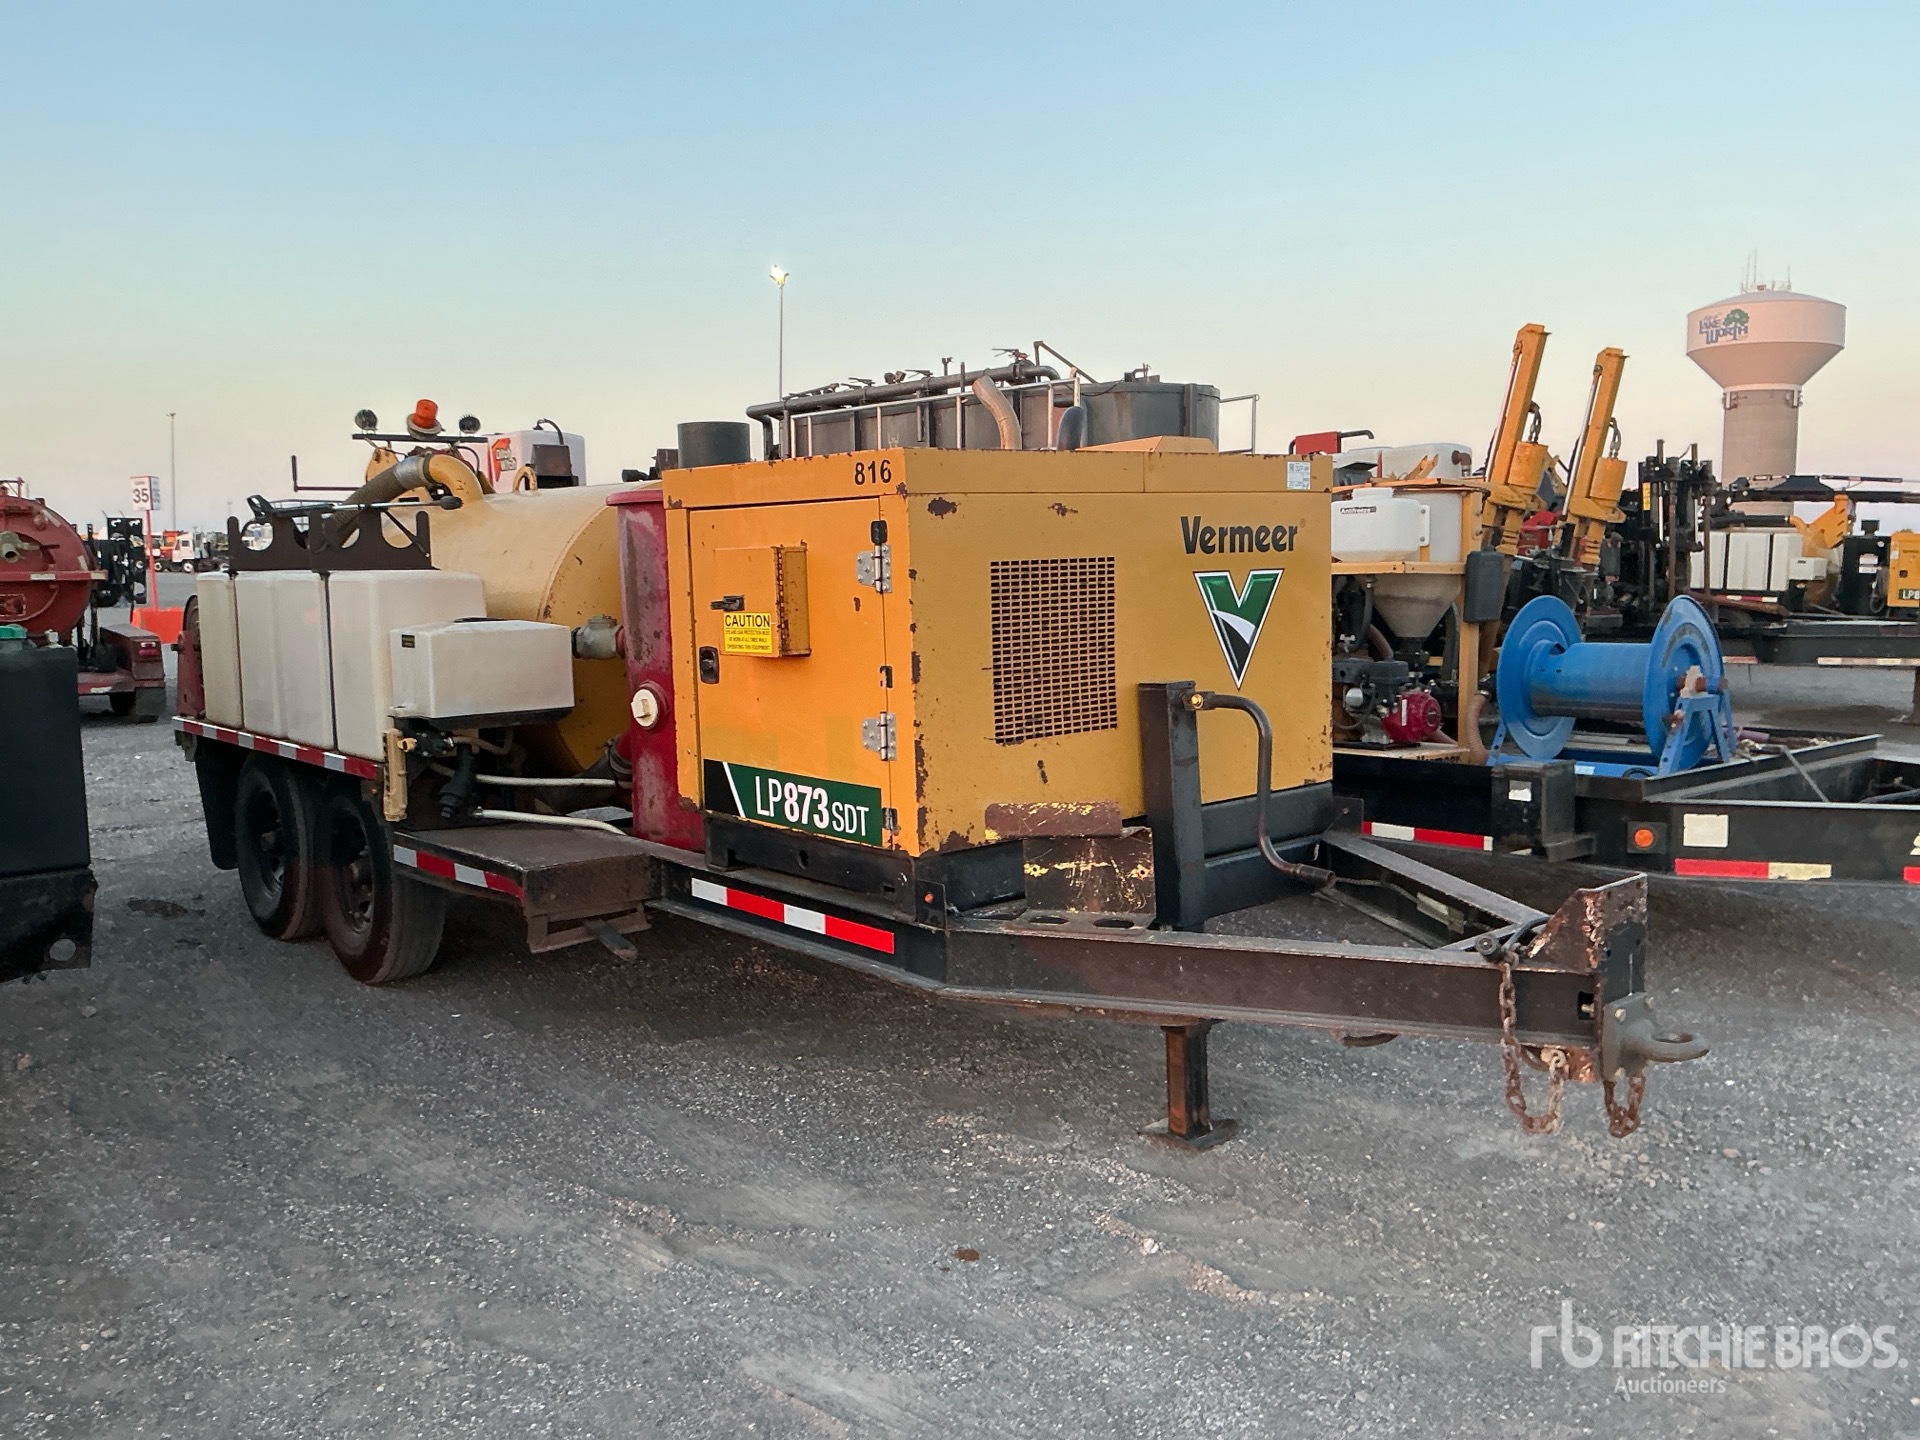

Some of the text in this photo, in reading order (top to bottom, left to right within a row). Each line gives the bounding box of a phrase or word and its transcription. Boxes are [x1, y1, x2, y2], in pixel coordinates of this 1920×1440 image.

[855, 459, 892, 486] 816
[133, 488, 150, 503] 35
[1180, 515, 1298, 554] Vermeer
[725, 614, 770, 627] CAUTION
